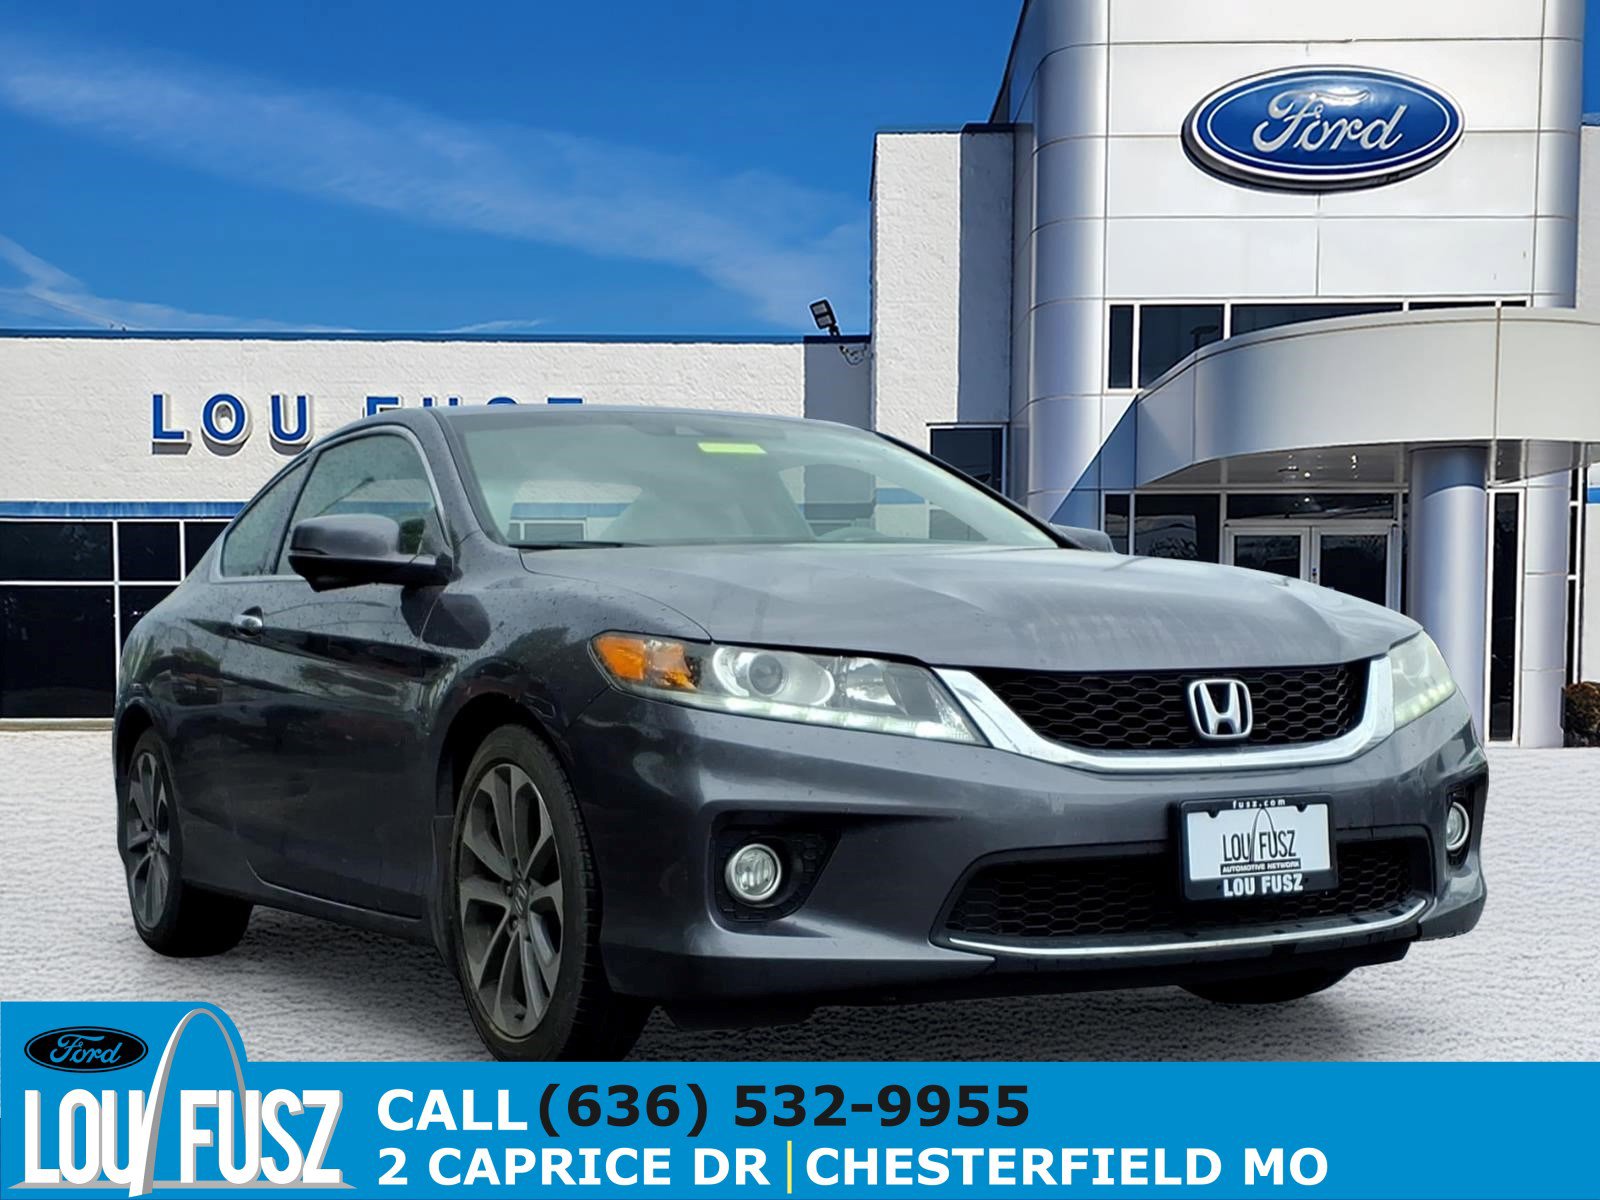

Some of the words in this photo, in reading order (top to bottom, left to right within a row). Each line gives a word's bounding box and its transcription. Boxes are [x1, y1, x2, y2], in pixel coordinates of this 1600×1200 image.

[1252, 89, 1407, 152] Ford
[151, 393, 312, 443] LOU
[1232, 799, 1286, 809] fusz.com
[1223, 834, 1251, 861] LOU
[1259, 830, 1296, 859] FUSZ
[1222, 863, 1266, 873] AUTOMOTIVE
[1267, 860, 1300, 870] NETWORK
[1223, 878, 1256, 897] LOU
[1261, 873, 1303, 894] FUSZ
